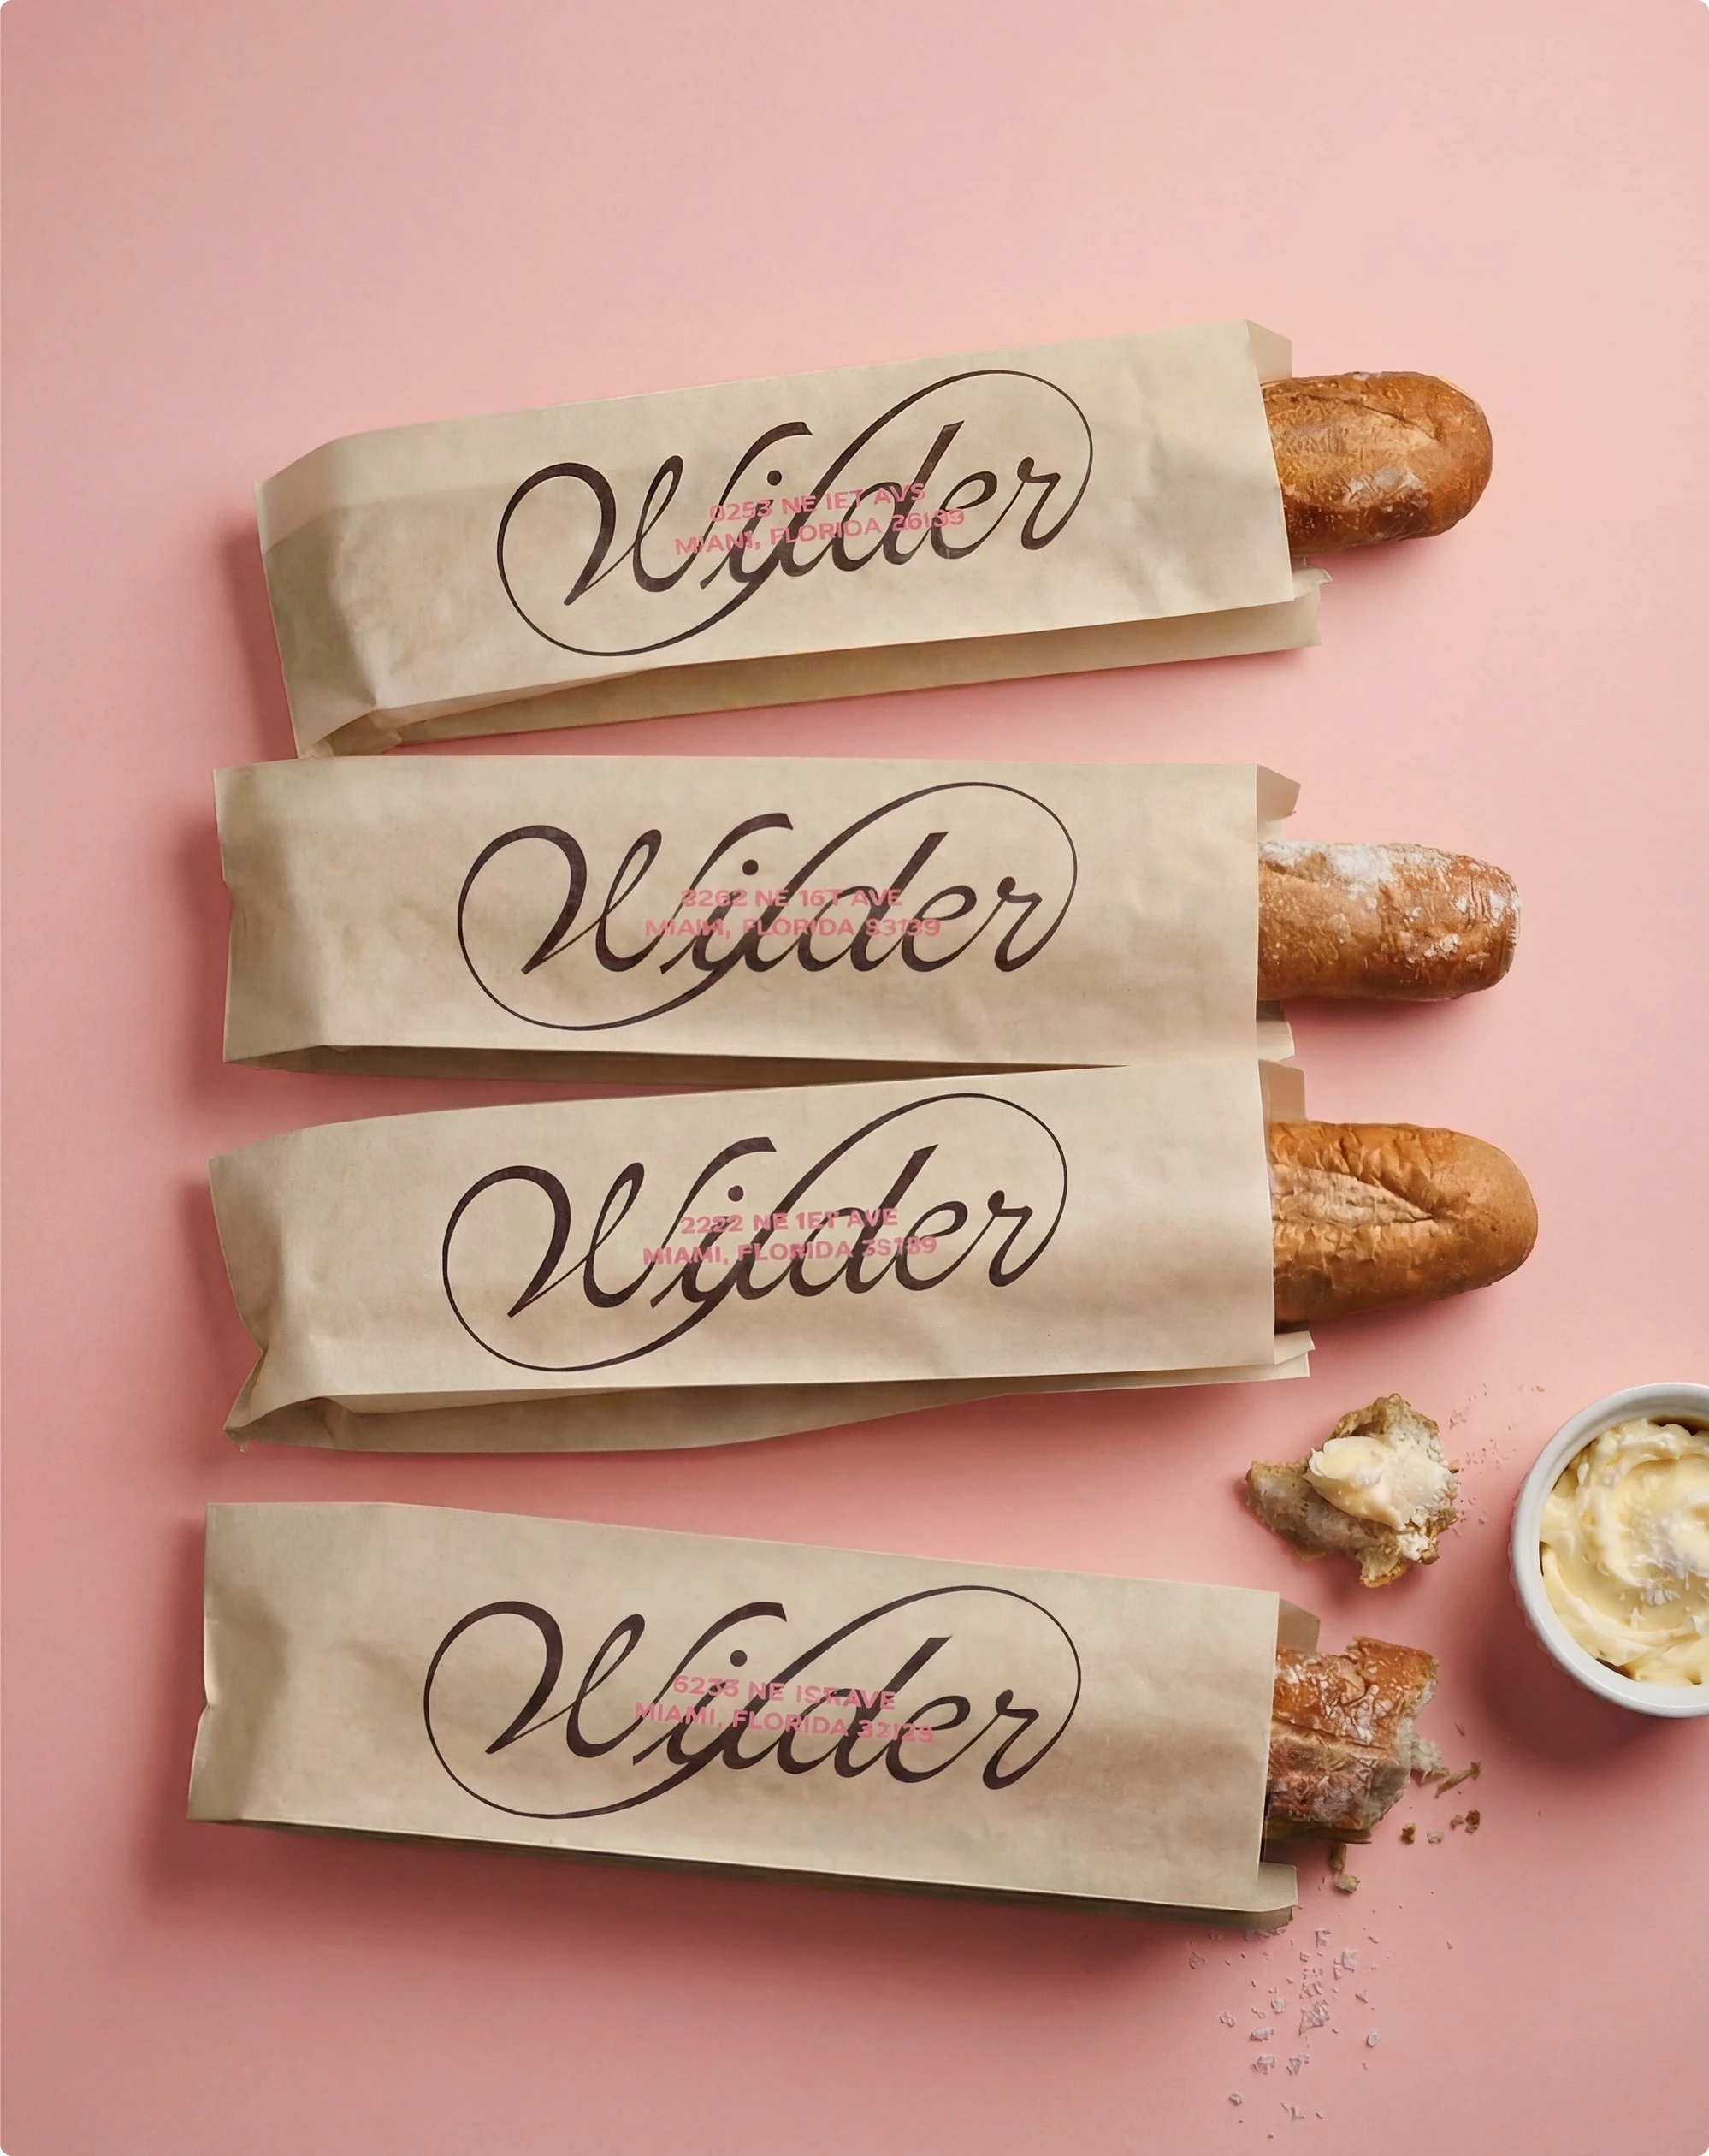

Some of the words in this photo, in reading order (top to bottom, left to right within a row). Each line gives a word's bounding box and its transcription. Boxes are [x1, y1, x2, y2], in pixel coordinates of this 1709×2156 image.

[496, 370, 1094, 656] Wilder
[781, 495, 818, 515] NE
[457, 781, 1078, 1031] Wilder
[754, 888, 790, 908] NE
[850, 888, 903, 908] AVE
[742, 917, 855, 937] FLORIDA
[441, 1093, 1068, 1372] Wilder
[753, 1212, 789, 1232] NE
[846, 1207, 899, 1229] AVE
[642, 1245, 730, 1266] MIAMI,
[736, 1240, 854, 1262] FLORIDA
[423, 1585, 1082, 1820] Wilder
[748, 1679, 785, 1703] NE
[634, 1701, 724, 1732] MIAMI,
[732, 1708, 849, 1738] FLORIDA
